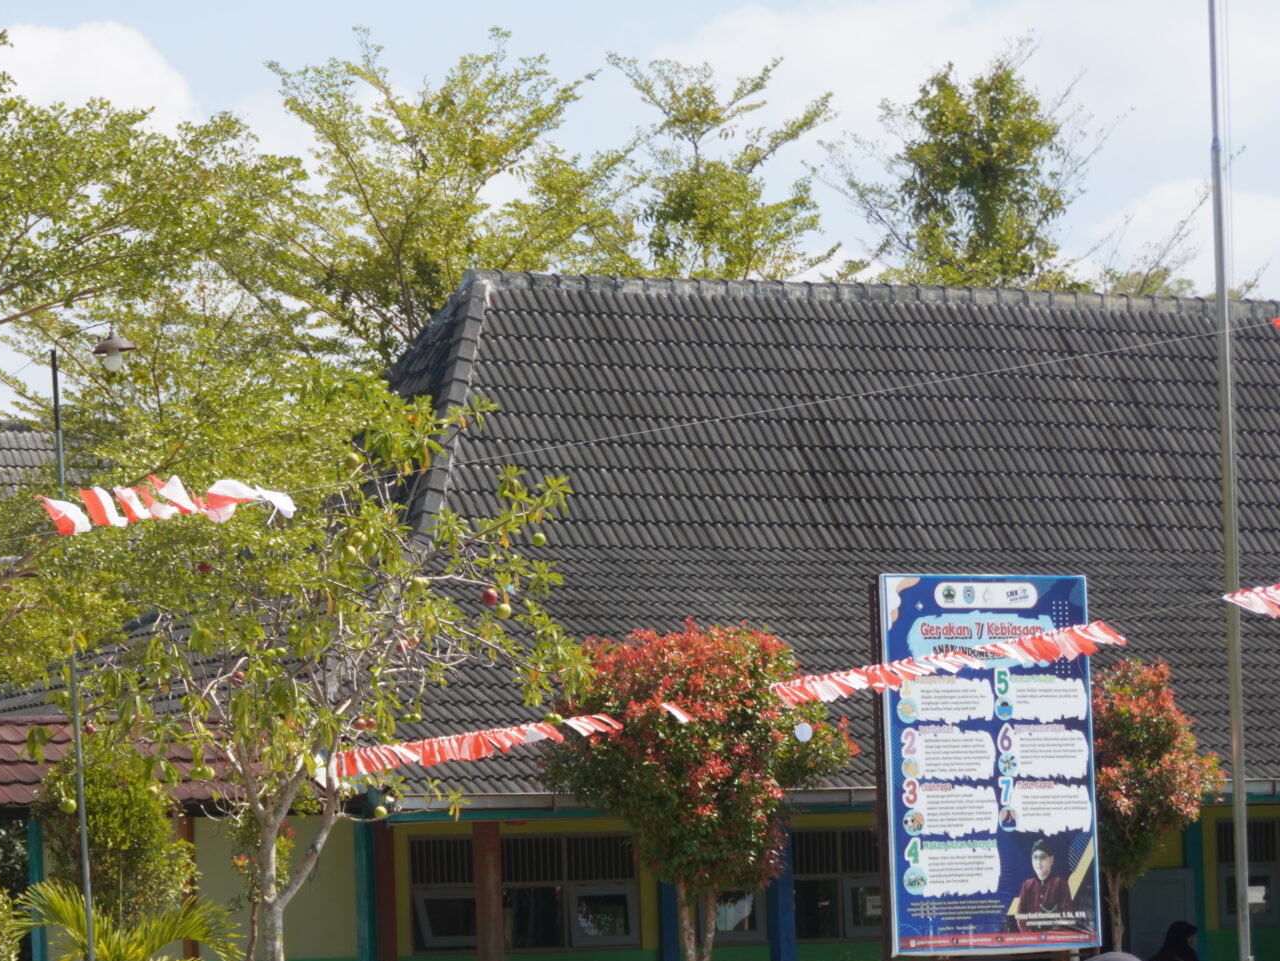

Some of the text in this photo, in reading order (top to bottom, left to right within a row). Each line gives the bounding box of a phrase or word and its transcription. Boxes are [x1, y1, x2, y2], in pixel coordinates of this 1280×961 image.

[920, 621, 1044, 639] Gerakan 7 Kebiasaan
[997, 671, 1009, 695] 5
[904, 731, 916, 755] 2
[1000, 727, 1012, 751] 6
[905, 781, 917, 804] 3
[1001, 780, 1011, 802] 7
[907, 841, 919, 864] 4
